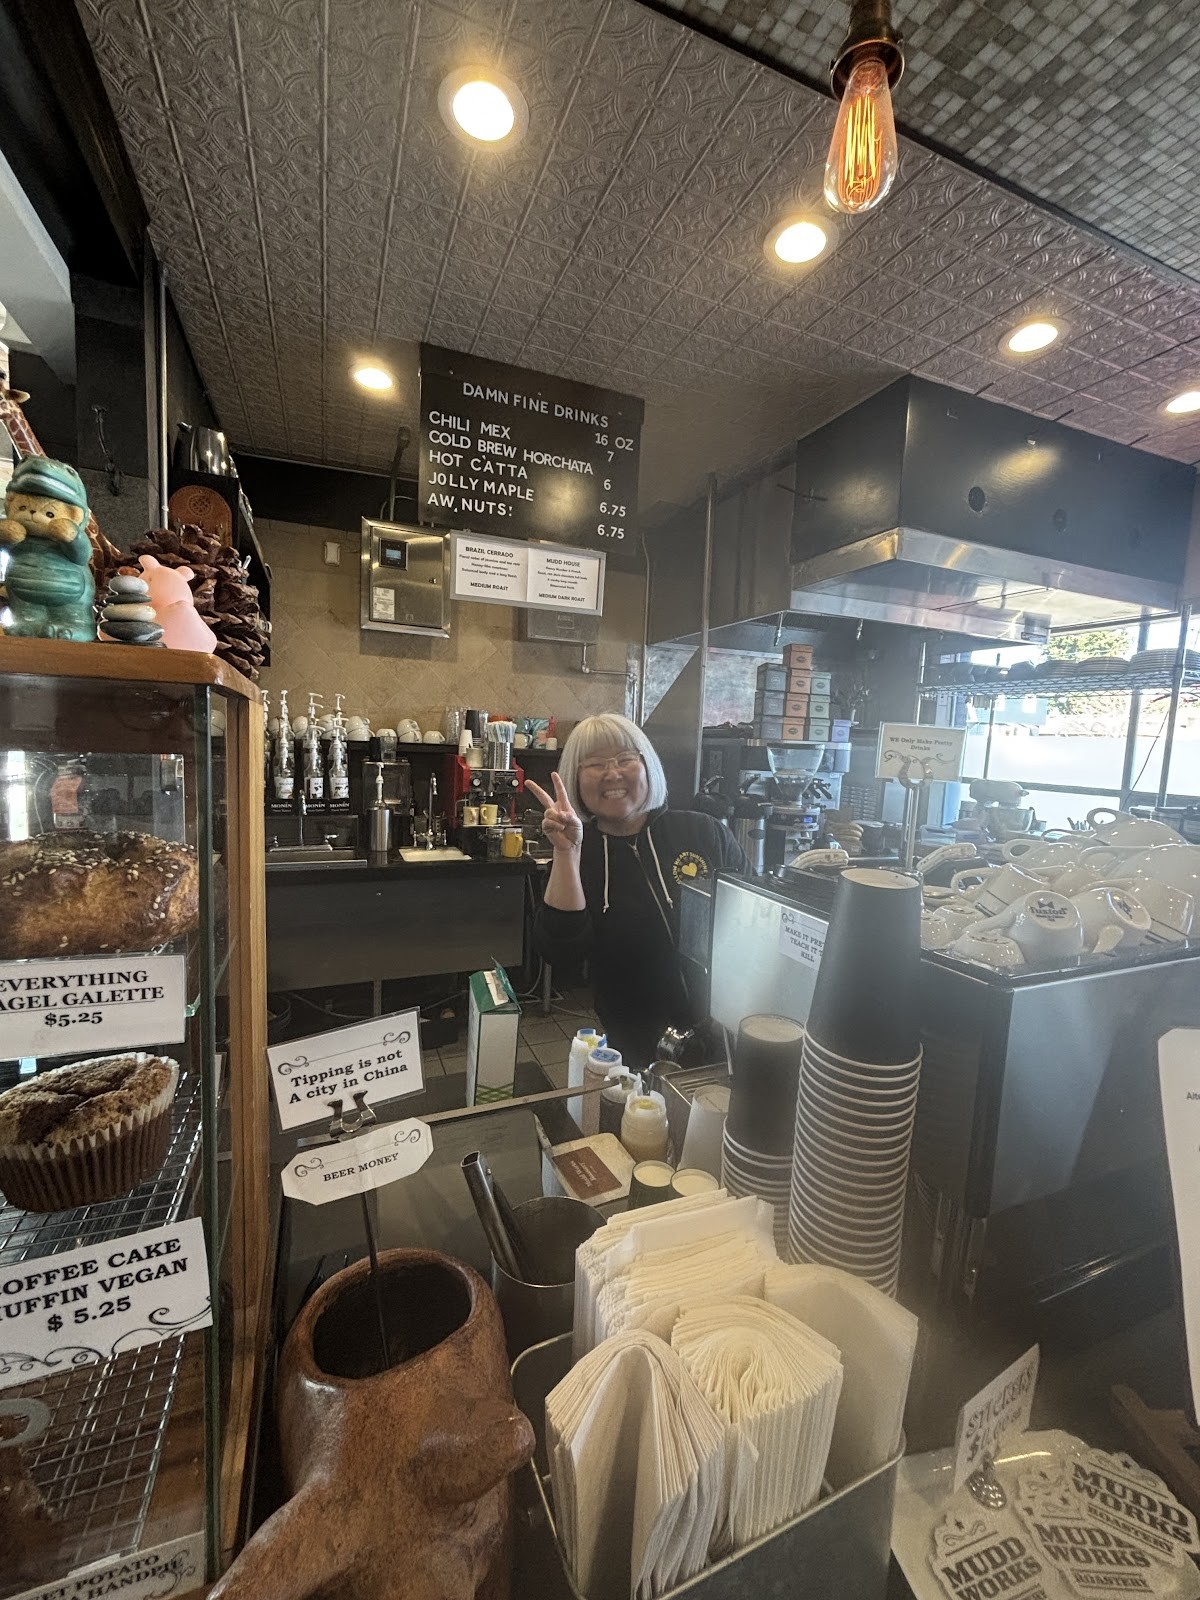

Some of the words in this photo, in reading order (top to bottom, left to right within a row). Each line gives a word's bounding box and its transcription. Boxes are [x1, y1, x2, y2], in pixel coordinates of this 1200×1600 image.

[462, 382, 509, 405] DAMN
[513, 395, 549, 414] FINE
[554, 404, 609, 428] DRINKS
[428, 410, 470, 431] CHILI
[480, 421, 511, 440] MEX
[428, 431, 471, 449] COLD
[477, 439, 517, 458] BREW
[523, 449, 594, 475] HORCHATA
[595, 433, 609, 446] 16
[614, 436, 634, 451] OZ
[429, 449, 464, 467] HOT
[606, 451, 615, 462] 7
[428, 471, 479, 491] JOLLY
[483, 480, 534, 502] MAPLE
[603, 479, 612, 491] 6
[599, 501, 627, 517] 6.75
[597, 523, 625, 540] 6.75
[465, 546, 485, 554] BRAZIL
[486, 549, 514, 558] CERRADO
[470, 581, 492, 589] MEDIUM
[785, 925, 802, 938] MAKE
[802, 933, 809, 942] IT
[810, 936, 825, 948] PRE
[790, 936, 810, 952] TEACH
[810, 946, 818, 955] IT
[801, 950, 815, 963] KILL
[0, 970, 149, 993] EVERYTHING
[62, 986, 165, 1006] GALETTE
[44, 1011, 103, 1028] $5.25
[290, 1063, 354, 1088] Tipping
[358, 1059, 372, 1070] is
[376, 1049, 403, 1066] not
[289, 1092, 302, 1105] A
[306, 1082, 338, 1100] city
[342, 1077, 359, 1089] in
[363, 1063, 409, 1082] China
[323, 1167, 355, 1182] BEER
[358, 1152, 399, 1173] MONEY
[0, 1259, 99, 1295] OFFEE
[107, 1238, 182, 1269] CAKE
[0, 1284, 89, 1321] UFFIN
[98, 1257, 188, 1294] VEGAN
[47, 1313, 64, 1333] $
[74, 1295, 132, 1325] 5.25
[1072, 1461, 1188, 1526] MUDD
[1072, 1476, 1192, 1545] WORKS
[941, 1536, 1026, 1590] MUDD
[1043, 1544, 1151, 1568] WORKS
[31, 1585, 70, 1600] ET
[75, 1555, 159, 1591] POTATO
[956, 1556, 1042, 1600] WORKS
